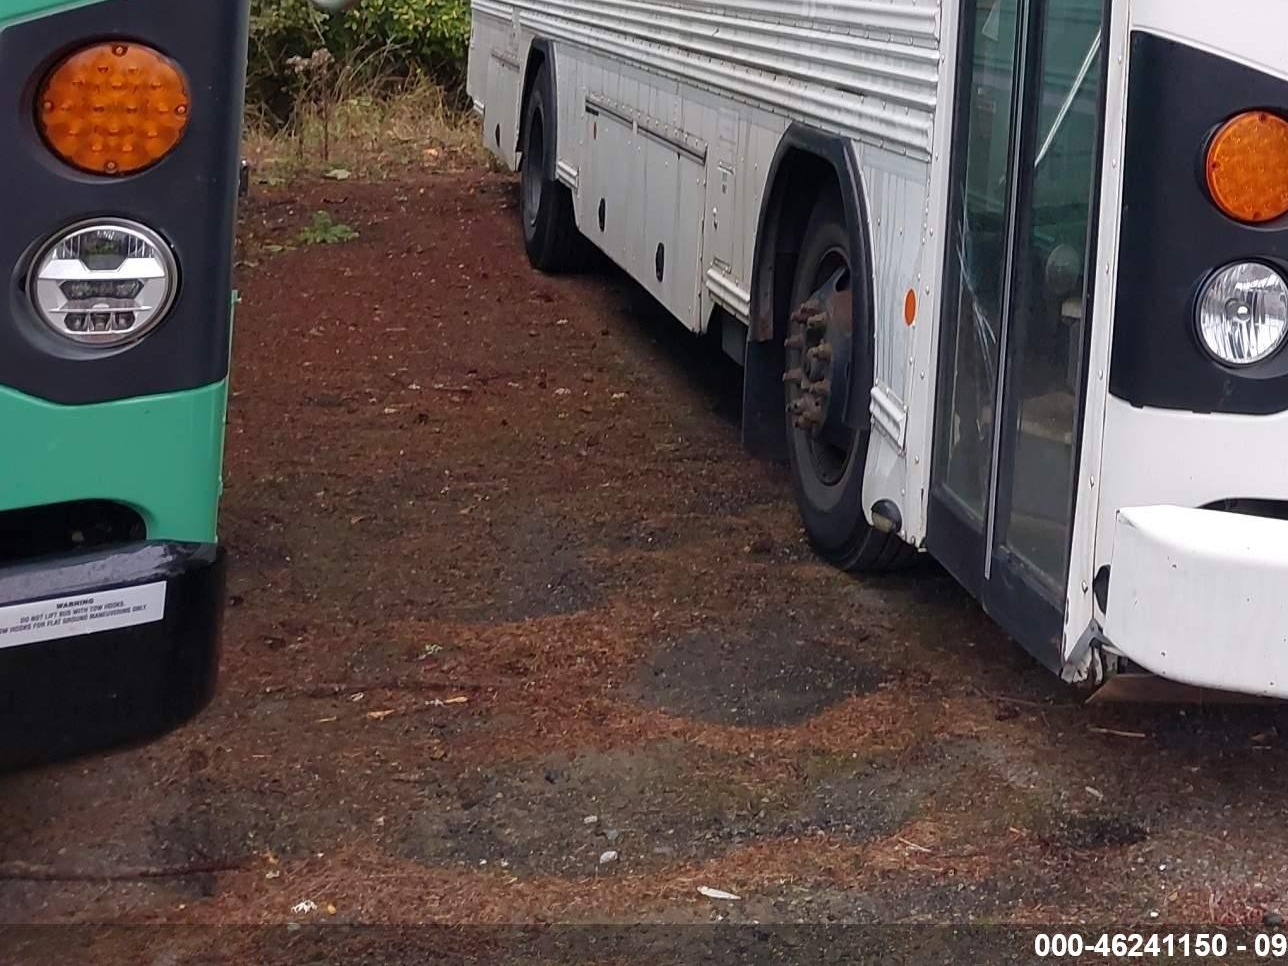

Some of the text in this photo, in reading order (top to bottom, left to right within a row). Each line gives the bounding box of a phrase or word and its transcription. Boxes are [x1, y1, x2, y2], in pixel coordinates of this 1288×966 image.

[56, 598, 94, 609] WARNING
[20, 616, 30, 624] DO
[31, 614, 43, 622] NOT
[44, 612, 57, 620] LIFT
[73, 607, 88, 615] WITH
[10, 624, 31, 632] HOOKS
[33, 621, 45, 629] FOR
[46, 618, 61, 626] FLAT
